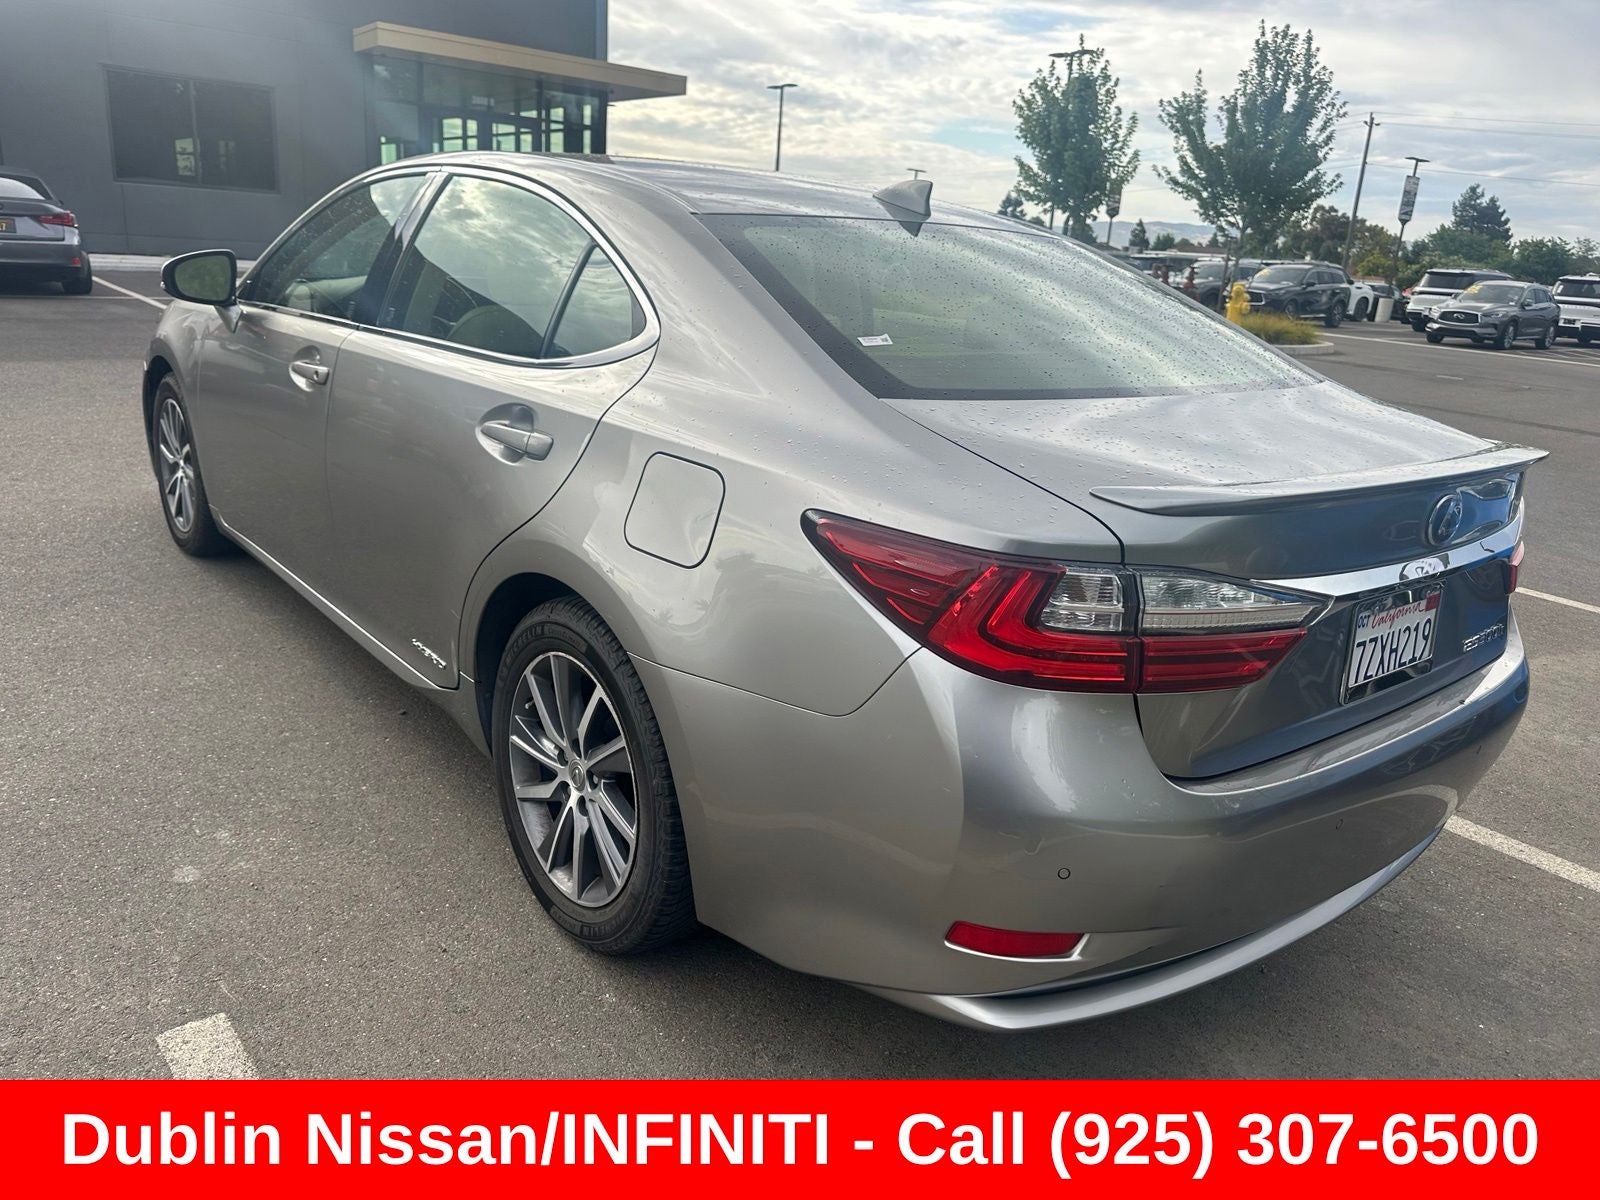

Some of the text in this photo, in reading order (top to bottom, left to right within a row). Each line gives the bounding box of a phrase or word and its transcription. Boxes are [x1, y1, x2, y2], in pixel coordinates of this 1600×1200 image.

[1357, 614, 1371, 629] OCT
[1371, 602, 1426, 629] California
[1354, 617, 1433, 687] 7ZXH219
